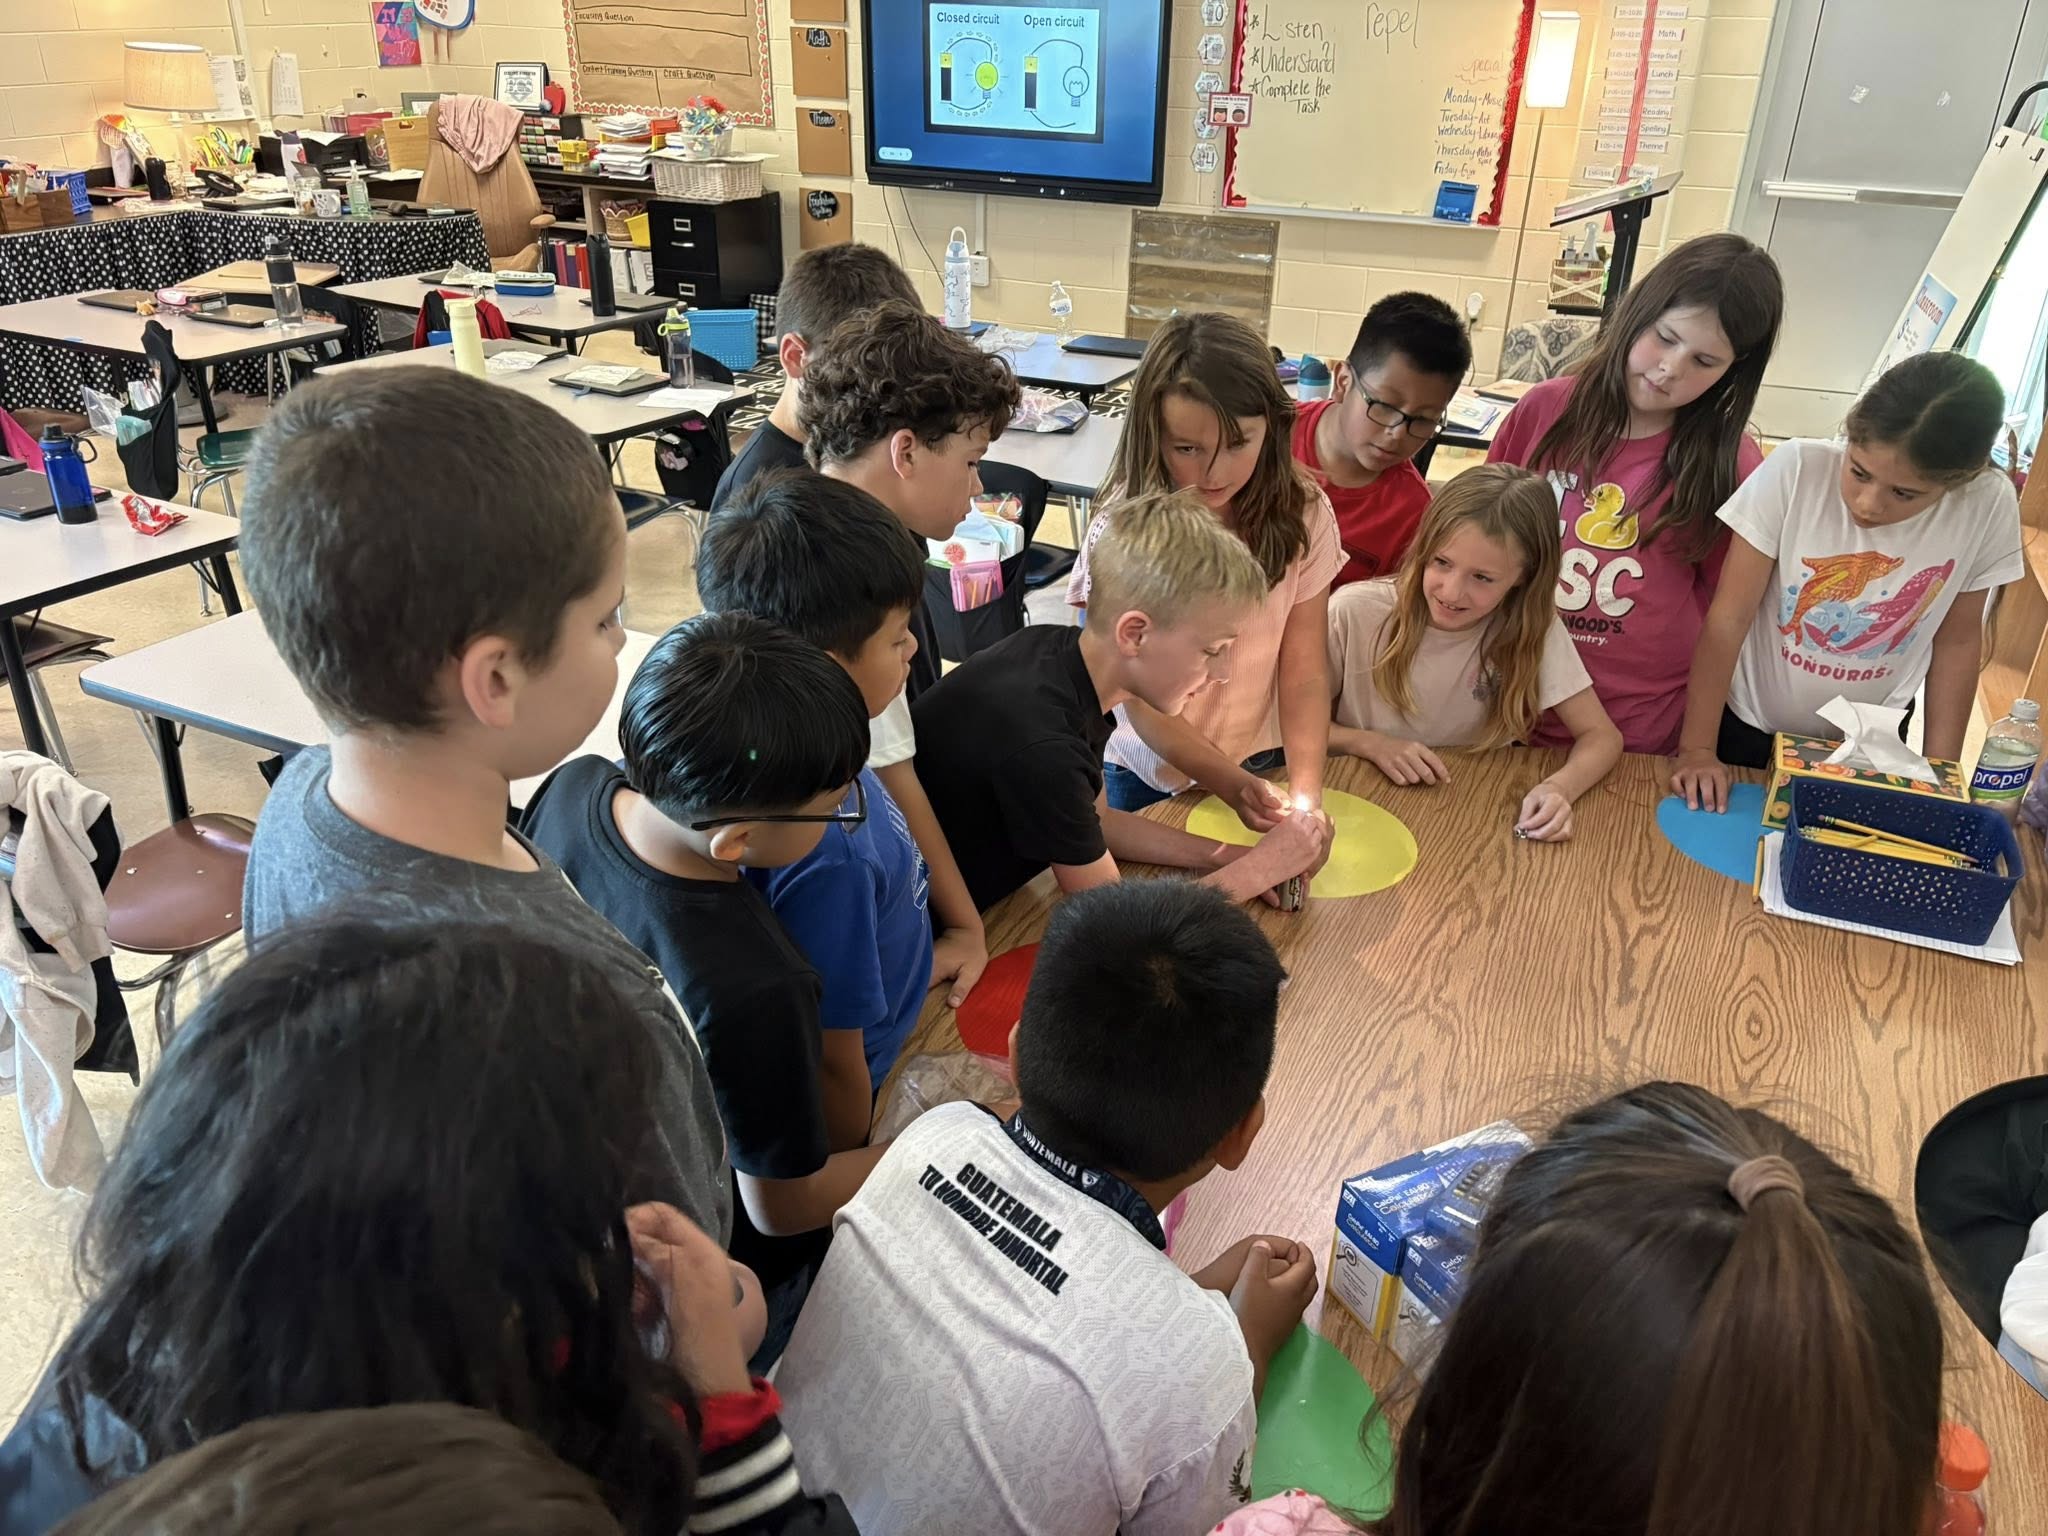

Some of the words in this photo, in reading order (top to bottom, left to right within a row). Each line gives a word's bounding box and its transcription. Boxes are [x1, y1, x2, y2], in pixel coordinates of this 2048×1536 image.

[604, 11, 635, 22] Question
[936, 11, 970, 24] Closed
[972, 13, 1000, 25] circuit
[1023, 14, 1052, 28] Open
[1054, 15, 1085, 28] circuit
[1261, 4, 1324, 41] Lsten
[1366, 0, 1420, 54] repel
[1658, 29, 1677, 38] Math
[1260, 43, 1336, 75] Understand
[627, 67, 654, 77] Question
[686, 71, 717, 81] Question
[1651, 69, 1674, 78] Lunch
[1261, 75, 1310, 102] Complete
[1315, 76, 1332, 98] the
[1289, 97, 1321, 114] Task
[1642, 106, 1670, 116] Reading
[1640, 123, 1667, 134] Spelling
[1639, 140, 1664, 150] Theme
[1915, 285, 1944, 326] Classroom
[1568, 631, 1608, 647] ountry.
[1973, 768, 2029, 789] propel
[1022, 1123, 1078, 1178] GUATEMALA
[1342, 1189, 1357, 1208] EAI
[956, 1162, 1063, 1253] GUATEMALA
[918, 1164, 942, 1192] TU
[933, 1177, 999, 1237] NOMBRE
[987, 1224, 1069, 1297] INMORTAL
